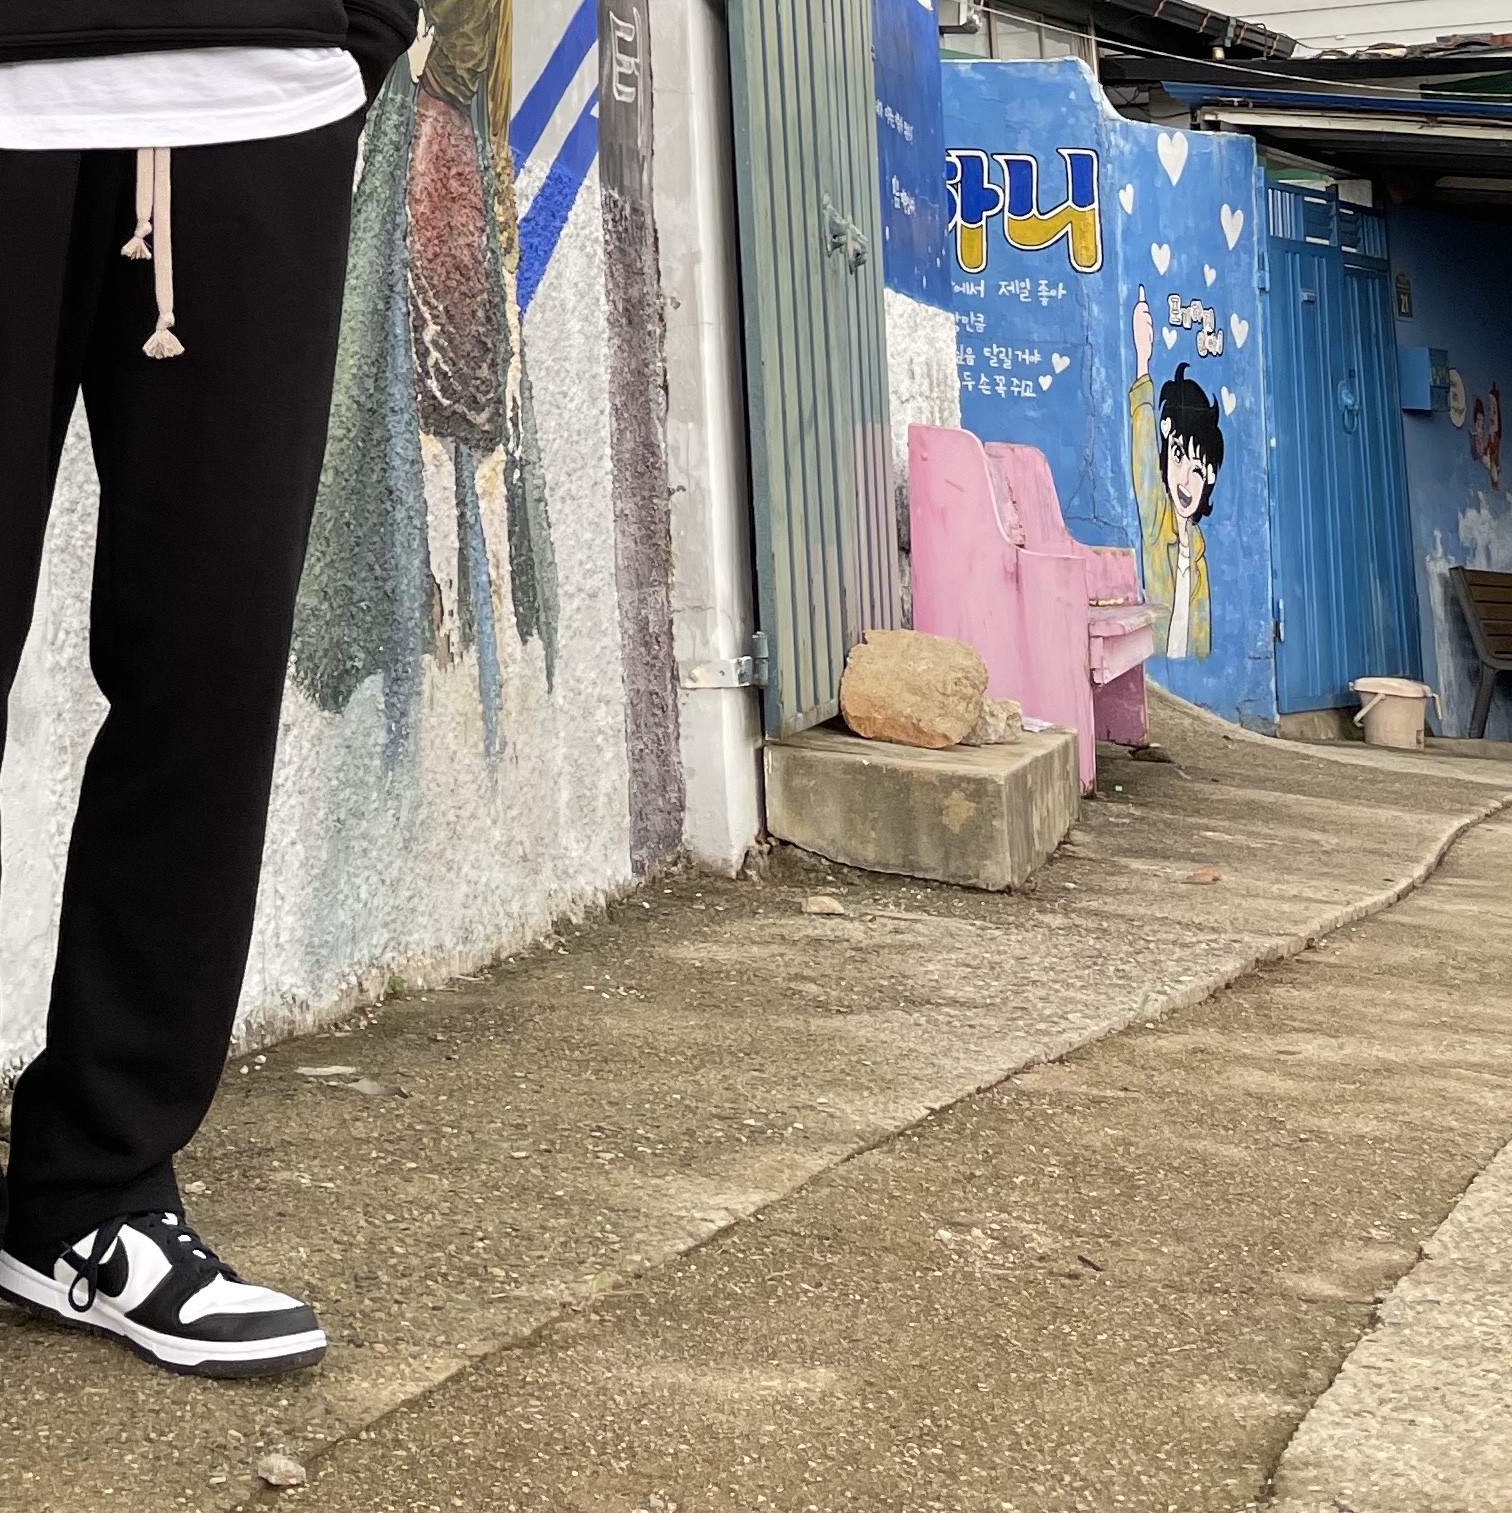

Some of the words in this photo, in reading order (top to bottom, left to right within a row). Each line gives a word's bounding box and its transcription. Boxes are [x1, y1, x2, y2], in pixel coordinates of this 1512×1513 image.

[951, 279, 985, 299] 에서
[997, 277, 1033, 303] 제일
[1037, 279, 1067, 307] 좋아
